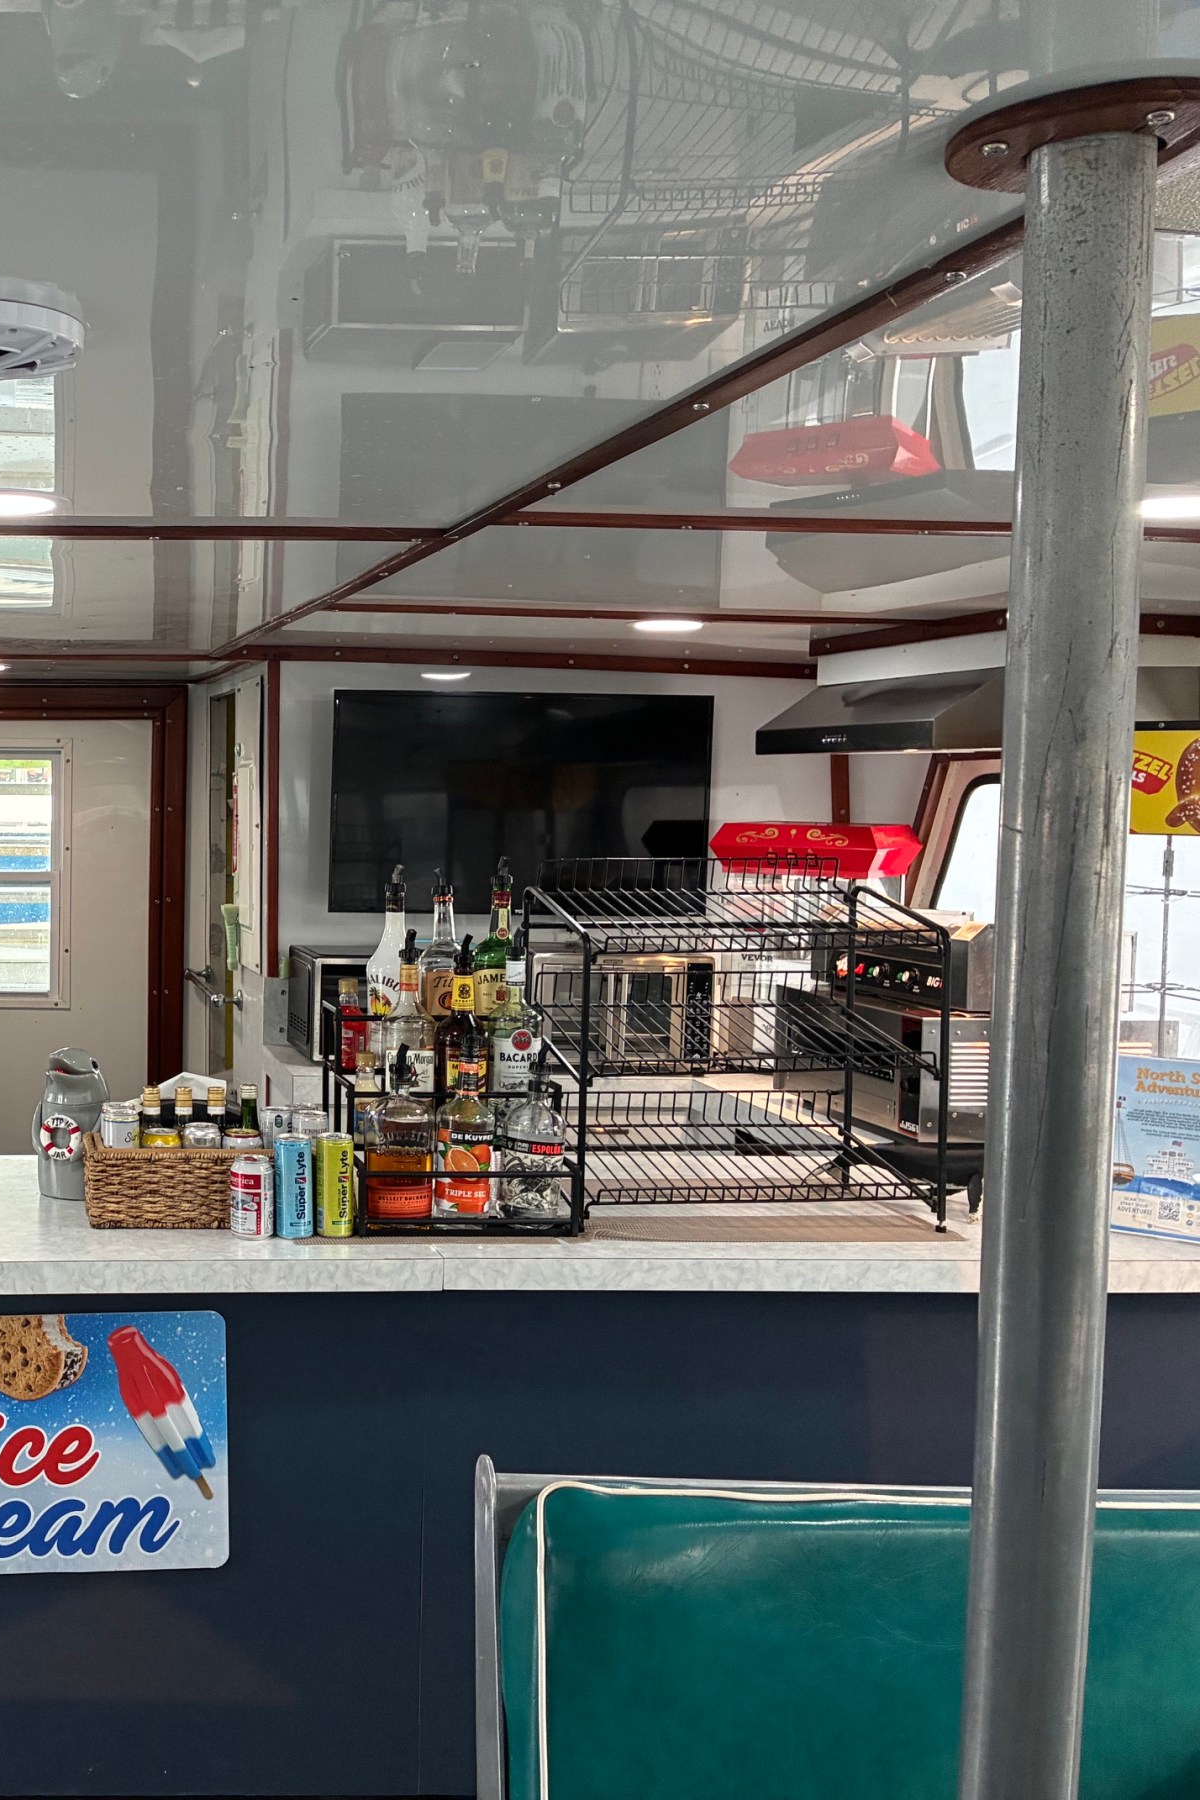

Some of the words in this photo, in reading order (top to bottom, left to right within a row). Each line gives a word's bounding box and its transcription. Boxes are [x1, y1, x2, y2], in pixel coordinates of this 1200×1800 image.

[741, 953, 773, 963] VEVOR
[434, 976, 454, 989] Tit
[477, 973, 506, 985] JAME
[500, 1053, 538, 1063] BACARD
[1136, 1067, 1186, 1083] North
[1191, 1072, 1200, 1085] S
[1135, 1080, 1200, 1098] Adventu
[297, 1151, 307, 1176] Lyte
[339, 1150, 349, 1175] Lyte
[339, 1184, 349, 1219] Super
[445, 1188, 472, 1198] TRIPLE
[475, 1189, 487, 1198] SEC
[296, 1185, 306, 1220] Super
